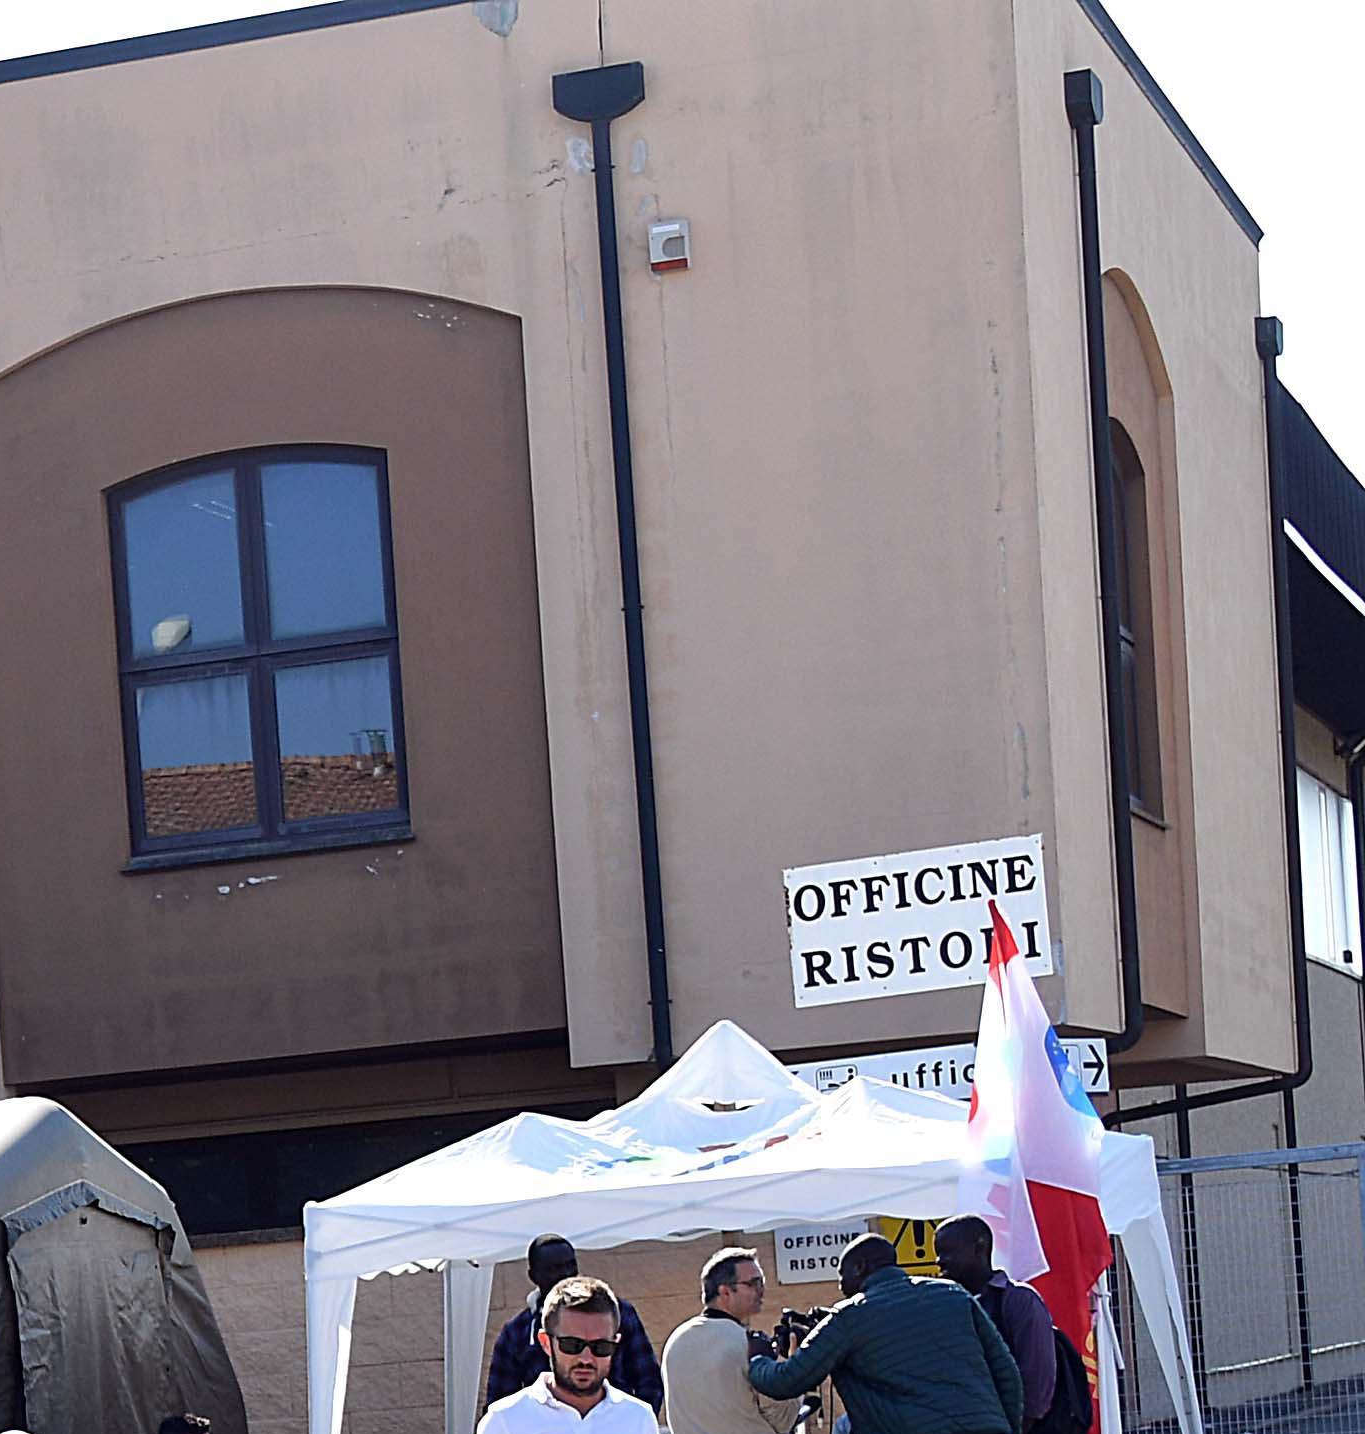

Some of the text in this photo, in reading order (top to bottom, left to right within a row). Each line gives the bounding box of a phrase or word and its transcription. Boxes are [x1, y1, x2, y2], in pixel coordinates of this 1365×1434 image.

[792, 853, 1037, 924] OFFICINE
[891, 1058, 977, 1088] uffic
[789, 1255, 840, 1271] RISTO
